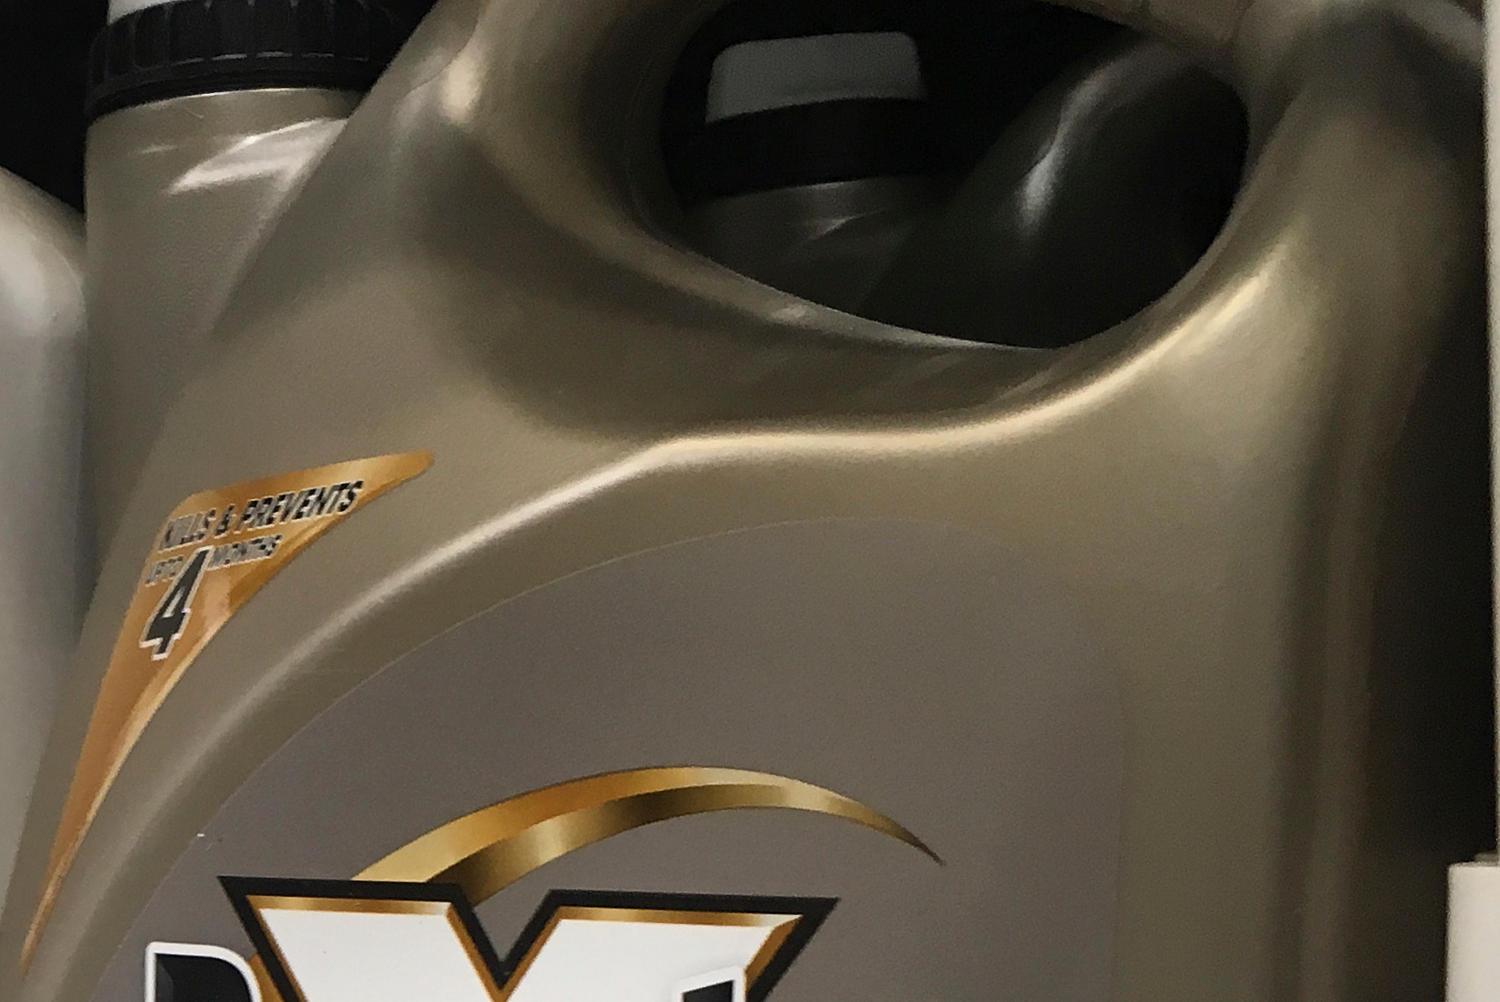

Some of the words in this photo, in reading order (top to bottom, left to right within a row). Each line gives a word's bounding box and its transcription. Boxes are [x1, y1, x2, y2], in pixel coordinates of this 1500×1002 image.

[214, 503, 236, 540] &
[233, 480, 364, 534] PREVENTS
[138, 546, 215, 661] 4
